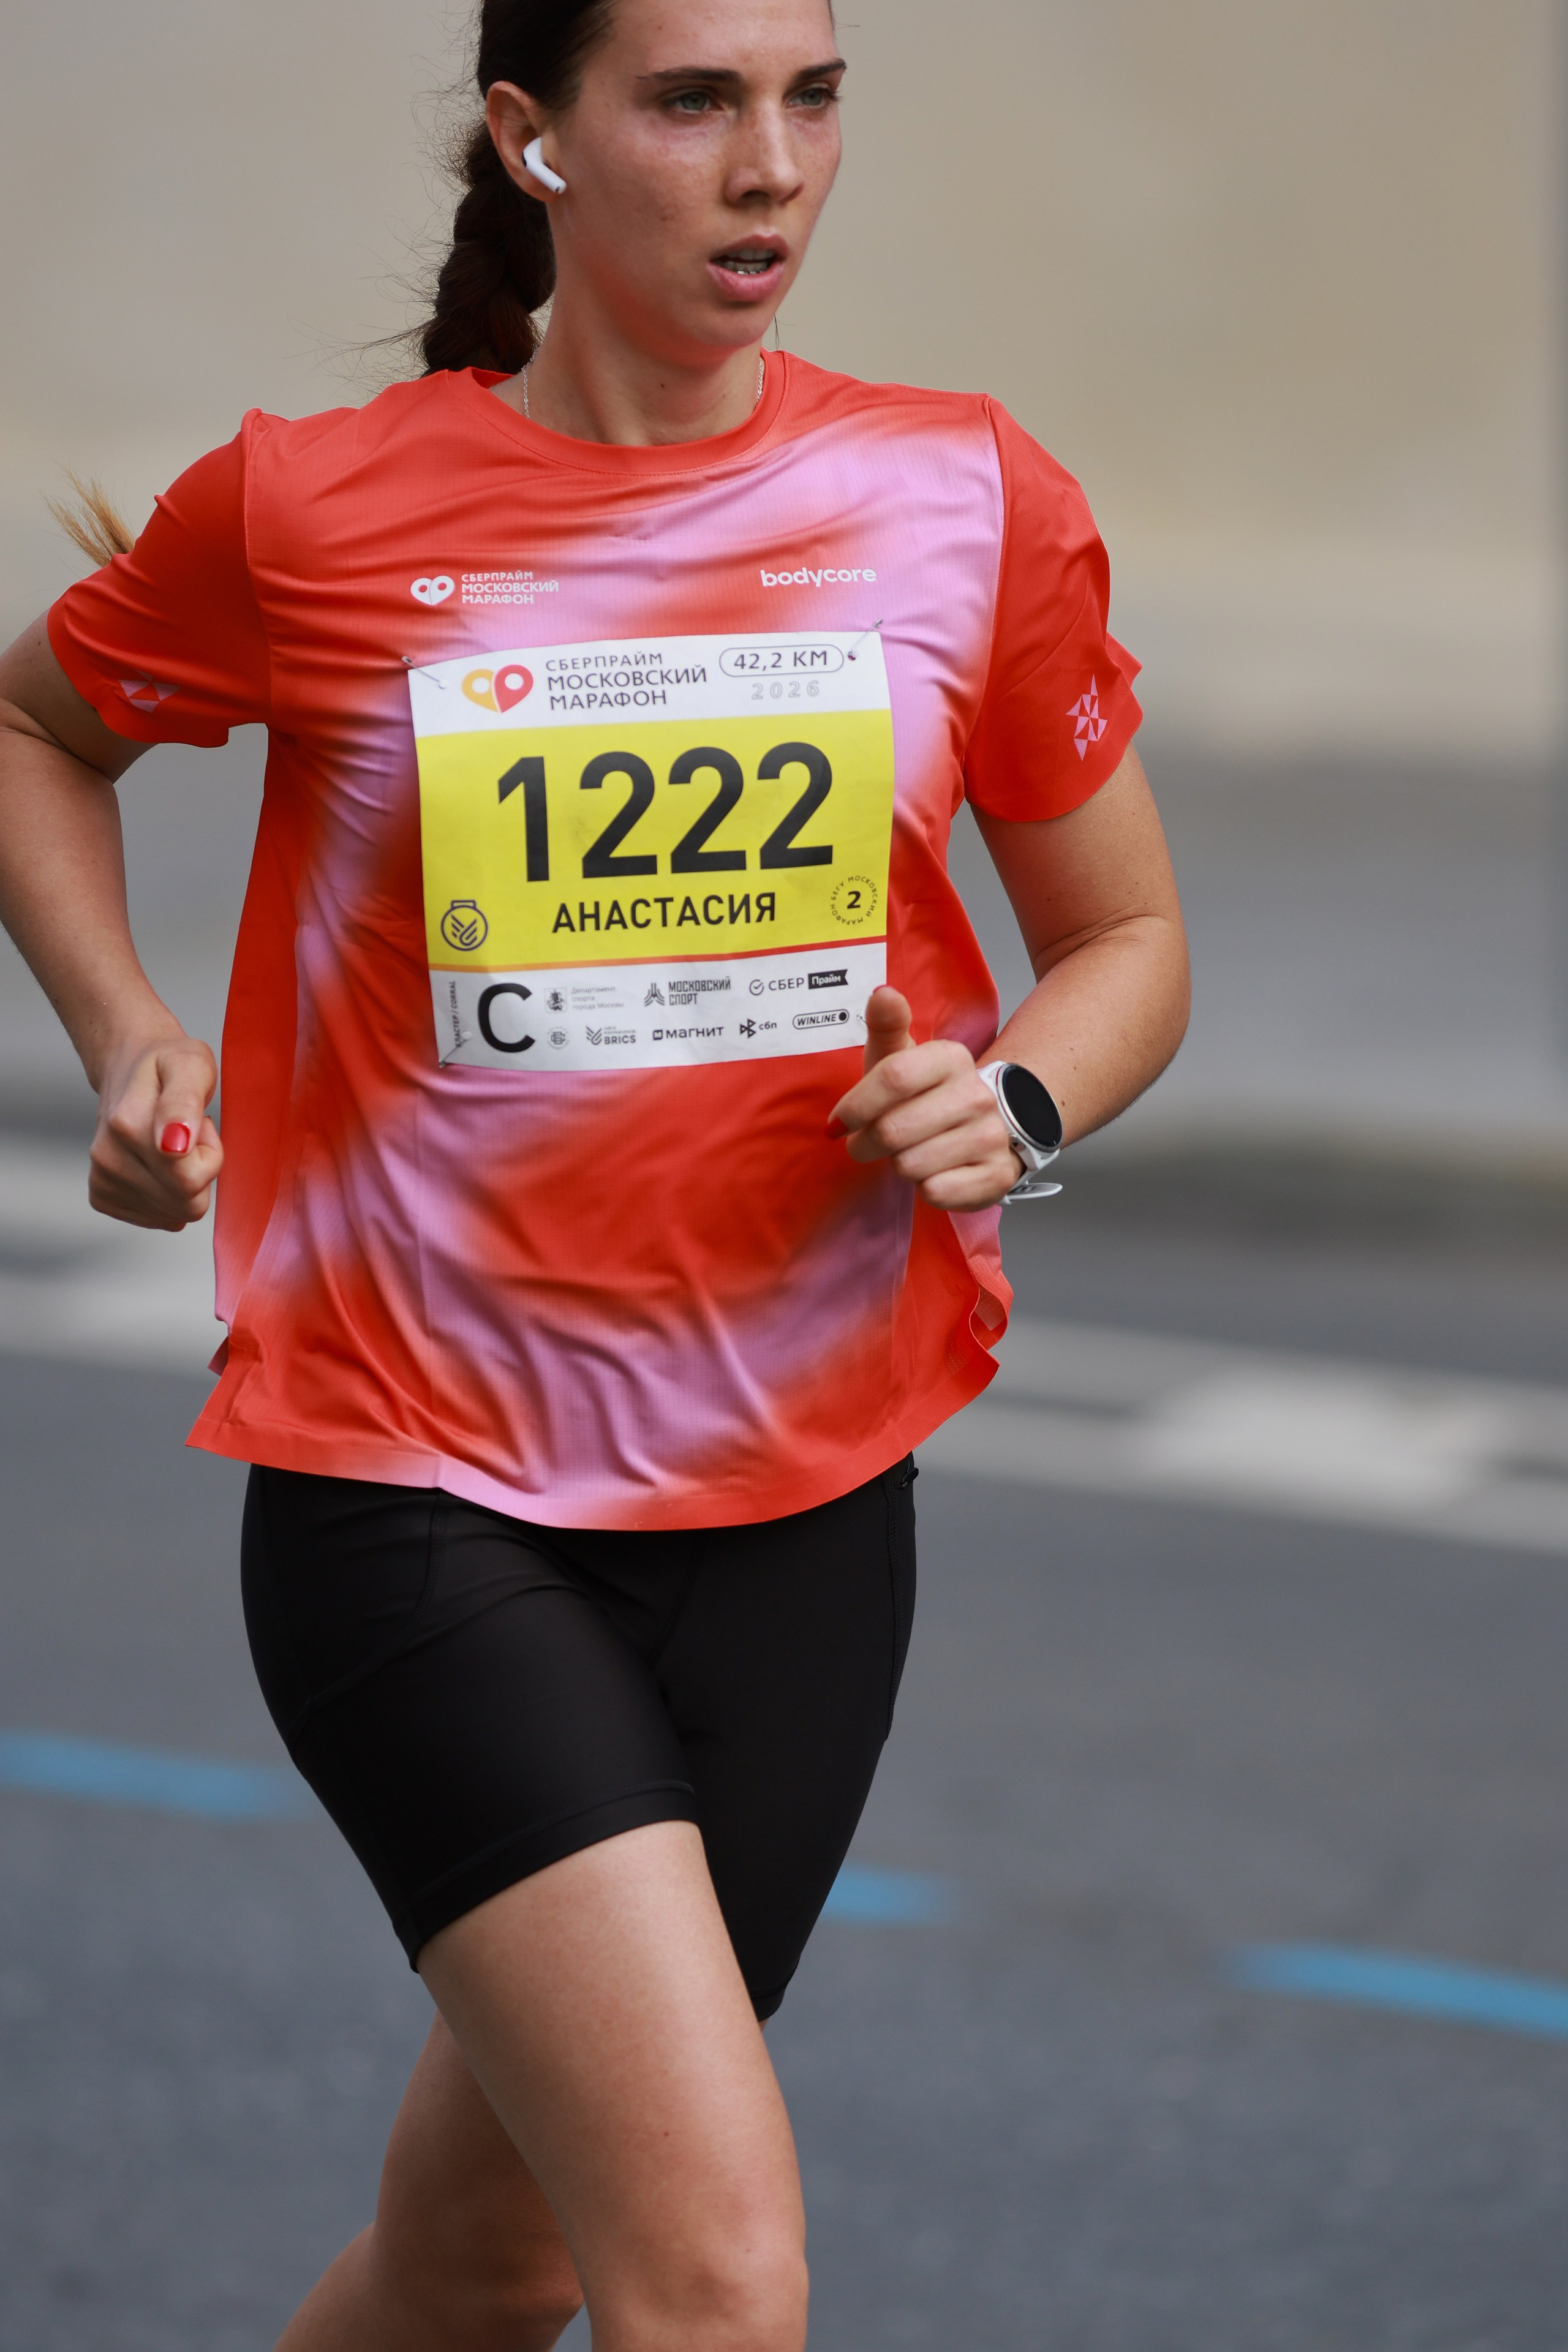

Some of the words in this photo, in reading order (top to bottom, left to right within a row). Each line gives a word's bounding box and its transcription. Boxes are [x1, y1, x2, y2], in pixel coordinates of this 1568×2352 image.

[462, 570, 533, 582] СБЕРПРАЙМ
[760, 567, 876, 587] bodycore
[462, 579, 559, 594] МОСКОВСКИЙ
[462, 594, 534, 604] МАРАФОН
[546, 651, 663, 671] СБЕРПРАЙМ
[734, 653, 782, 671] 42,2
[793, 650, 827, 667] КМ
[548, 664, 707, 690] МОСКОВСКИЙ
[752, 680, 819, 699] 2026
[550, 690, 666, 710] МАРАФОН
[497, 742, 833, 882] 1222
[846, 891, 861, 909] 2
[552, 892, 775, 933] АНАСТАСИЯ
[668, 976, 731, 992] МОСКОВСКИЙ
[769, 978, 804, 990] СБЕР
[812, 974, 841, 986] Прайм
[669, 993, 697, 1005] СПОРТ
[759, 1021, 777, 1030] сбп
[797, 1013, 837, 1026] WINLINE
[605, 1035, 636, 1045] BRICS
